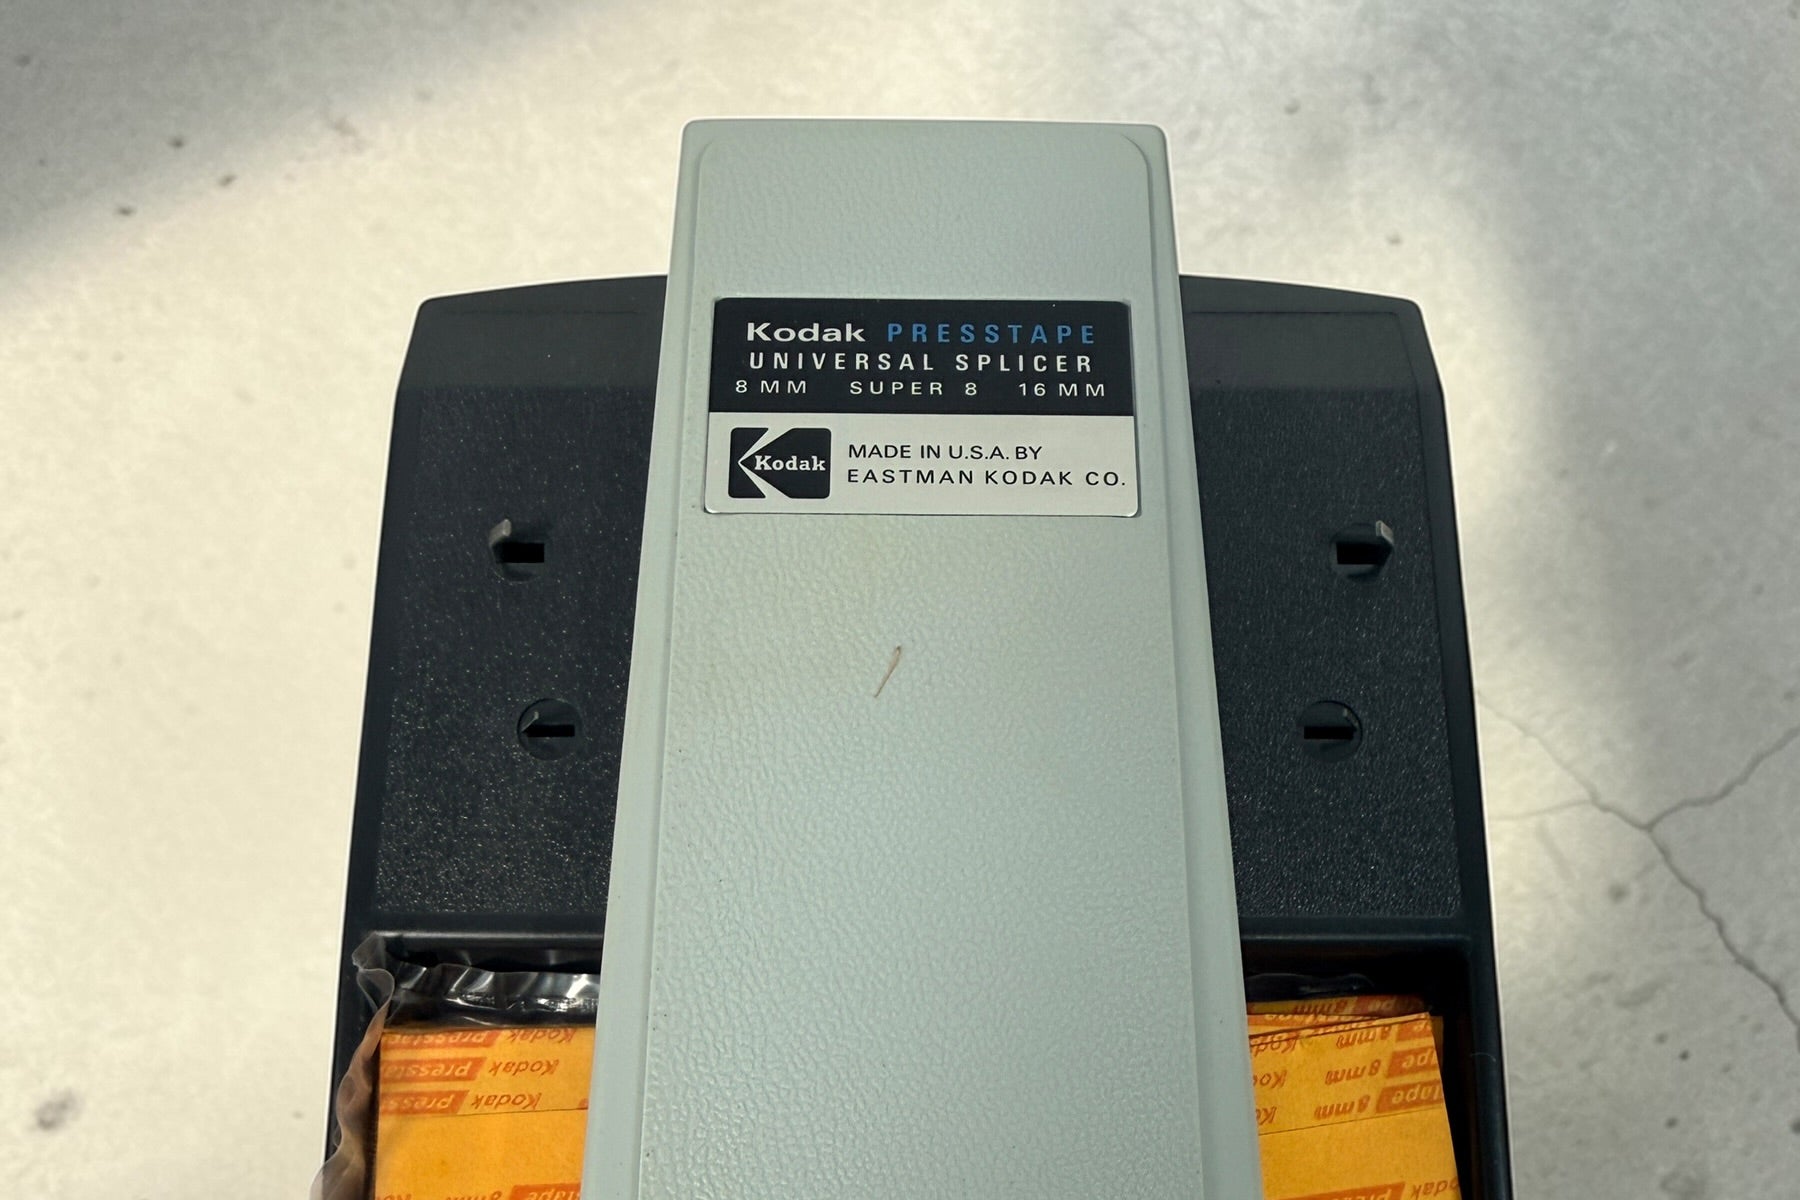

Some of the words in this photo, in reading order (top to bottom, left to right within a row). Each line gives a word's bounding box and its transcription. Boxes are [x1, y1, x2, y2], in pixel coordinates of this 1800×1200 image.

[746, 322, 866, 343] Kodak
[887, 324, 1095, 345] PRESSTAPE
[749, 352, 934, 372] UNIVERSAL
[955, 354, 1092, 373] SPLICER
[735, 380, 748, 394] 8
[760, 380, 807, 394] MM
[849, 381, 944, 396] SUPER
[964, 382, 978, 397] 8
[1018, 382, 1046, 397] 16
[1059, 383, 1105, 398] MM
[848, 444, 912, 460] MADE
[919, 444, 941, 460] IN
[948, 445, 1010, 460] U.S.A.
[1015, 446, 1043, 461] BY
[754, 455, 826, 472] Kodak
[847, 469, 973, 485] EASTMAN
[984, 470, 1073, 486] KODAK
[1085, 471, 1126, 487] CO.
[488, 1059, 559, 1076] Kodak
[1325, 1059, 1381, 1086] 8mm
[471, 1092, 542, 1110] Kodak
[1314, 1095, 1371, 1120] 8mm
